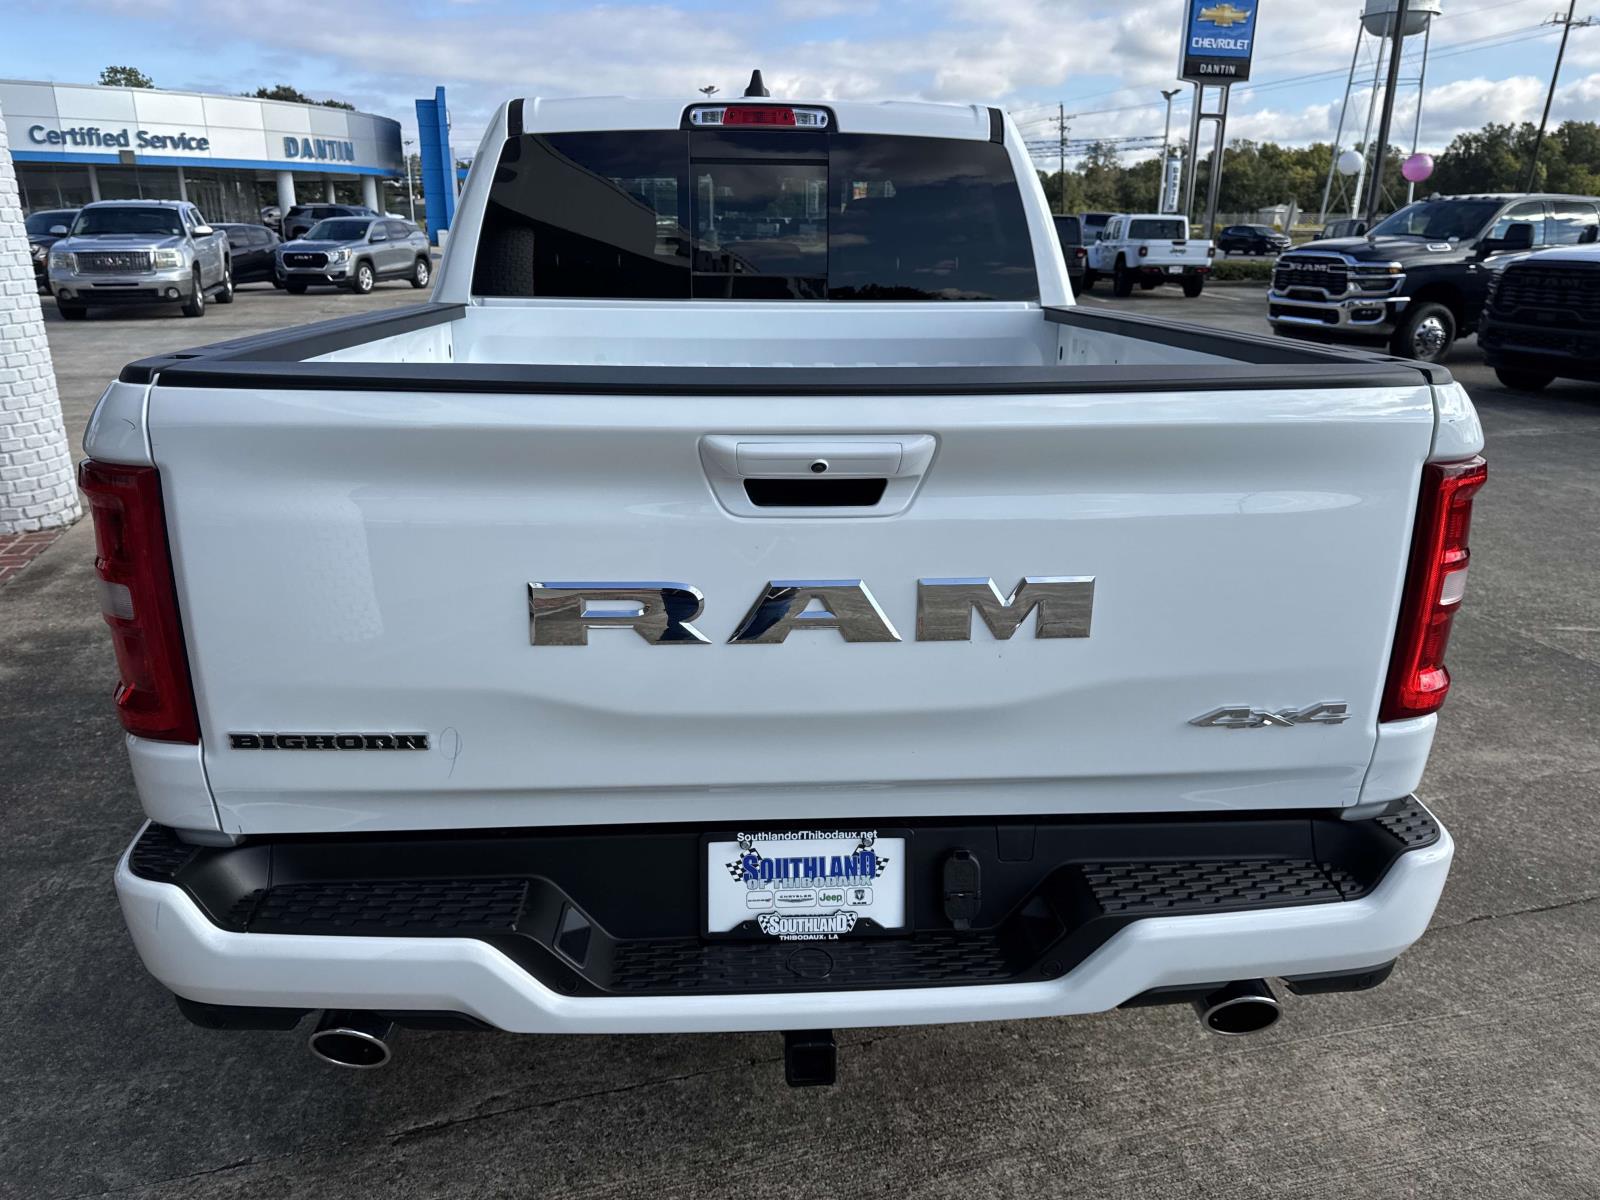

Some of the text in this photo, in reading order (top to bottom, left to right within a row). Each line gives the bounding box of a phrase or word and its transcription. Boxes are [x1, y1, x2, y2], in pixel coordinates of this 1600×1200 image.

[1191, 37, 1250, 50] CHEVROLET
[1199, 63, 1236, 75] DANTIN
[29, 124, 210, 151] Certified Service
[283, 136, 355, 162] DANTIN
[528, 575, 1096, 646] RAM
[227, 731, 429, 751] BIGHORN
[736, 830, 878, 842] SouthlandofThibodaux.net
[742, 850, 876, 883] SOUTHLAND
[746, 875, 873, 890] OF THIBODAUX
[819, 893, 843, 903] Jeep
[769, 914, 848, 934] SOUTHLAND
